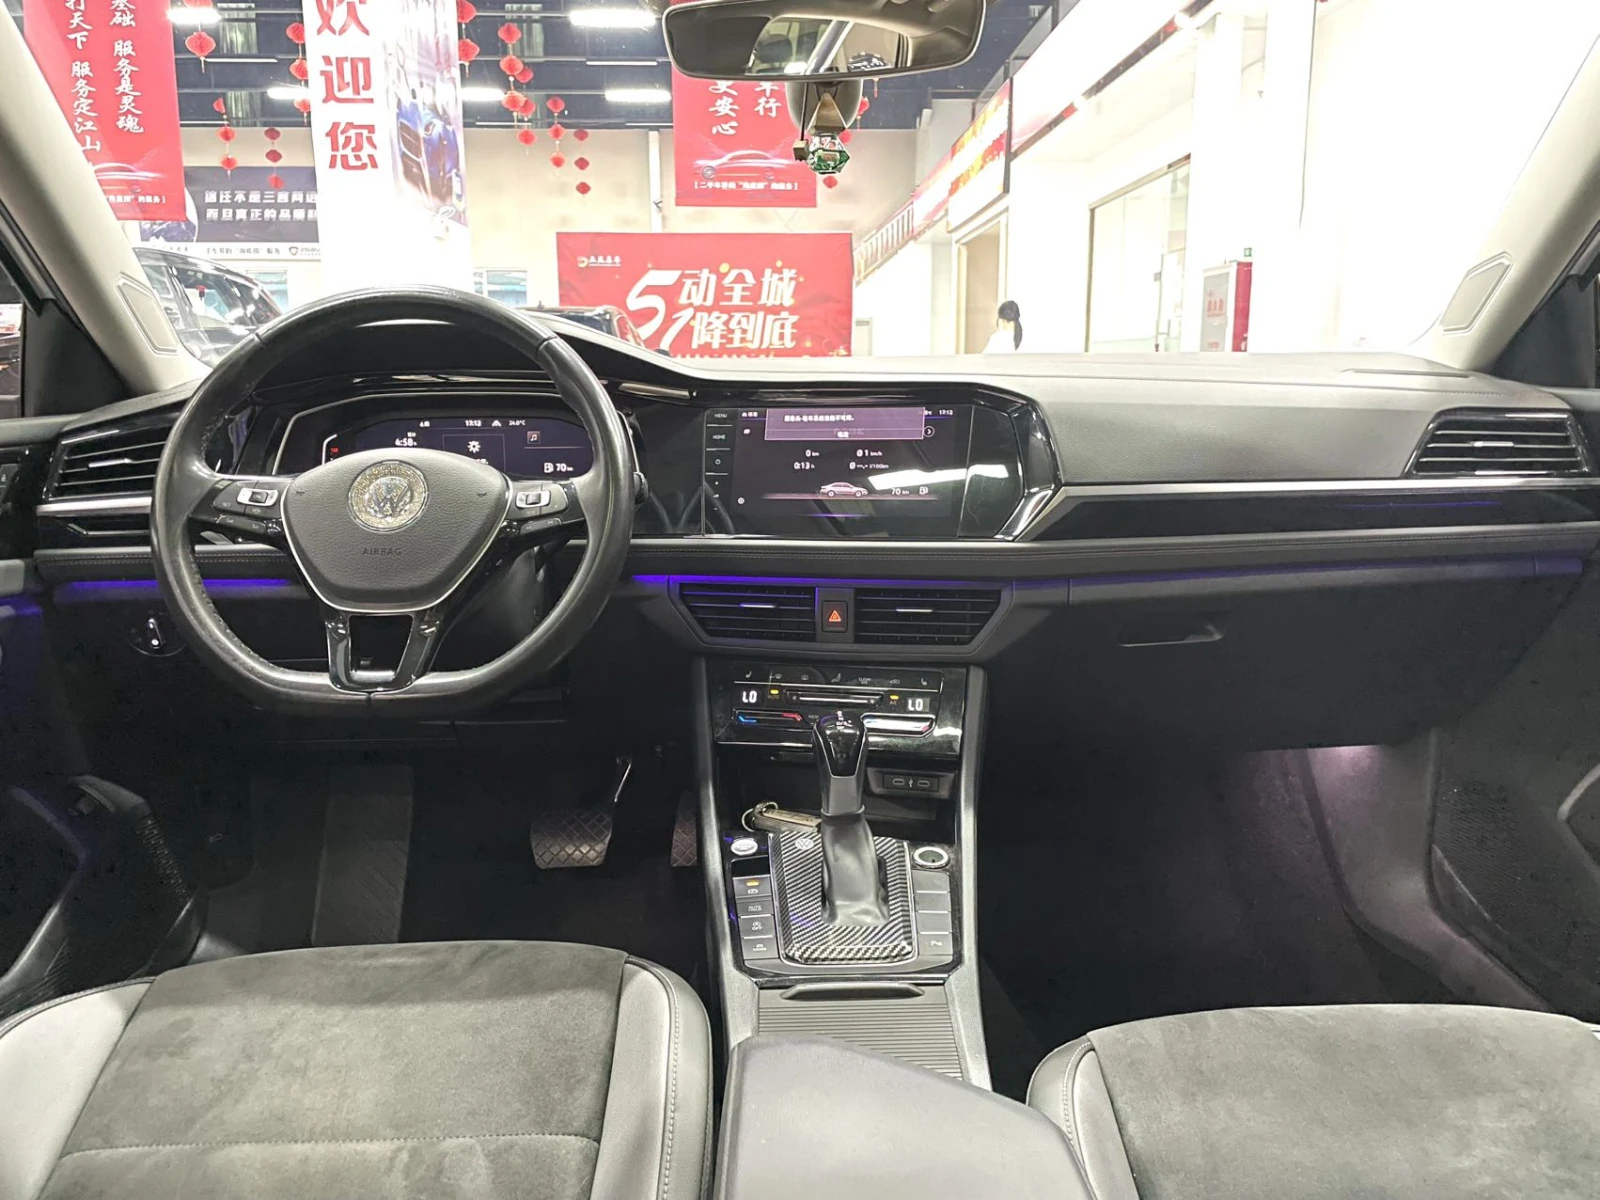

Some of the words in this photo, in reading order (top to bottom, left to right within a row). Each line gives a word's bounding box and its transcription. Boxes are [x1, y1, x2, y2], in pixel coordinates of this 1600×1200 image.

[113, 39, 144, 133] 服务是灵魂
[316, 0, 379, 171] 欢迎您
[678, 267, 798, 308] 动全城
[691, 310, 800, 350] 降到底
[891, 487, 901, 496] 70
[362, 547, 402, 556] AIRBAG
